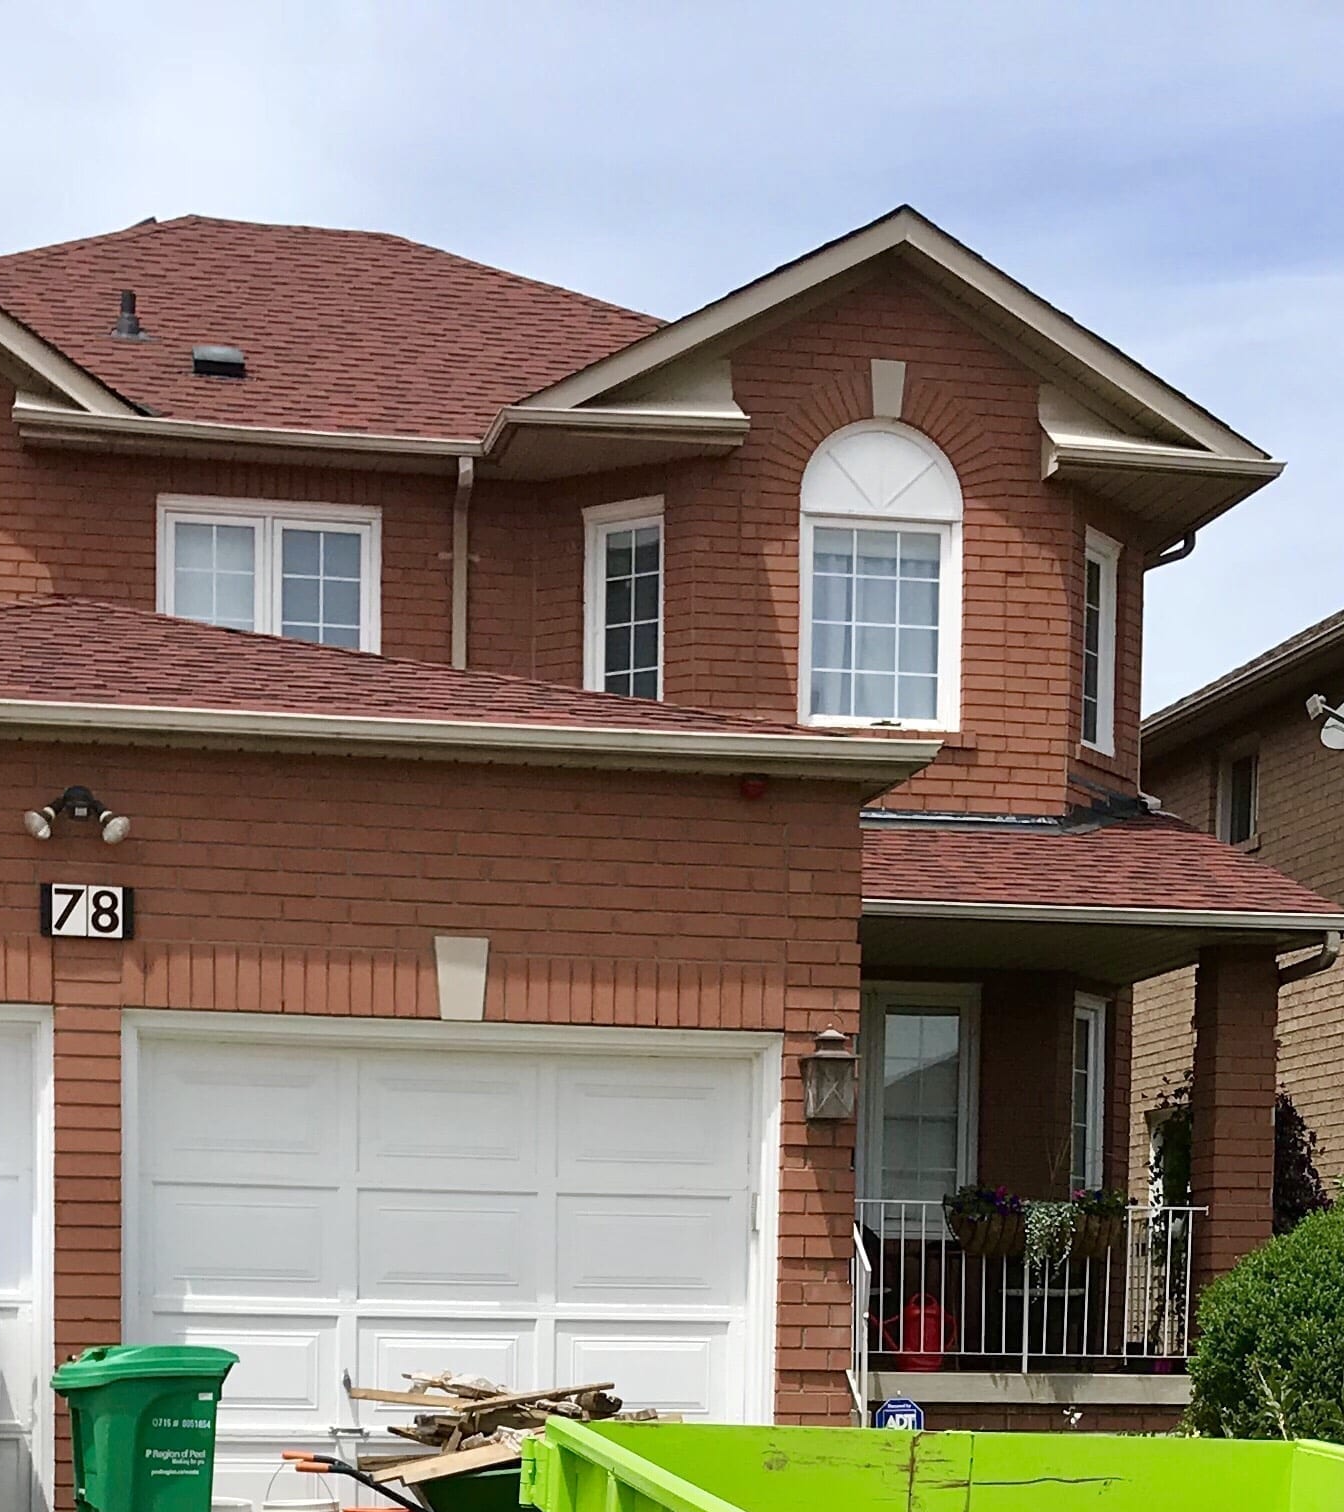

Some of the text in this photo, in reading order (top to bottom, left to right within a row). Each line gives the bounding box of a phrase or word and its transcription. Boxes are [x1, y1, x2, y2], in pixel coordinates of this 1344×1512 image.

[54, 888, 119, 933] 78
[886, 1413, 916, 1430] ADT
[152, 1449, 181, 1460] Region
